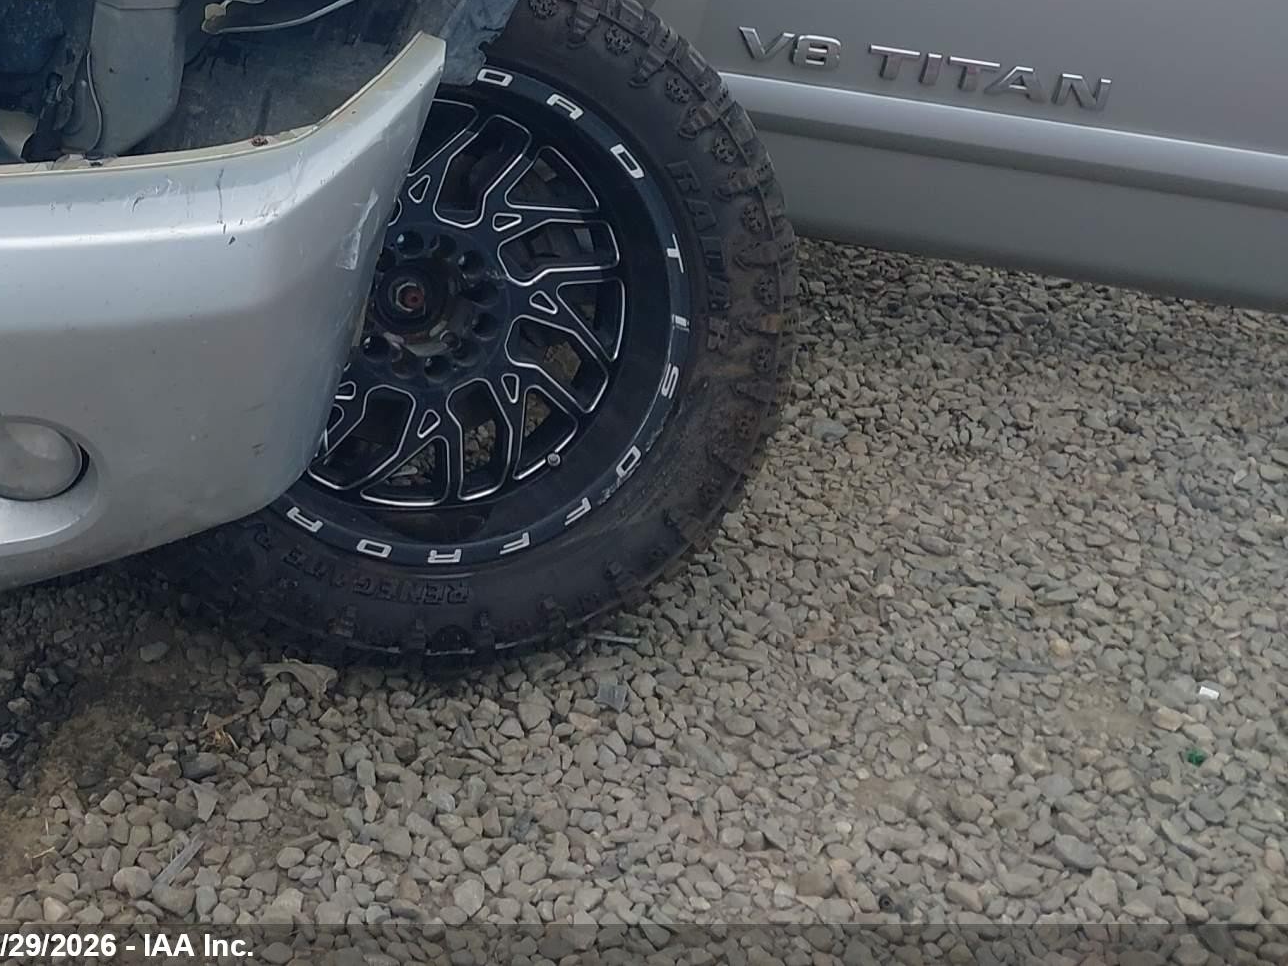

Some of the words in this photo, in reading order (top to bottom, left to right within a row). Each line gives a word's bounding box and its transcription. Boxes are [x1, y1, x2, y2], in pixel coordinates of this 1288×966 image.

[739, 26, 841, 68] V8
[869, 44, 1112, 111] TITAN
[286, 445, 643, 564] OFFROA
